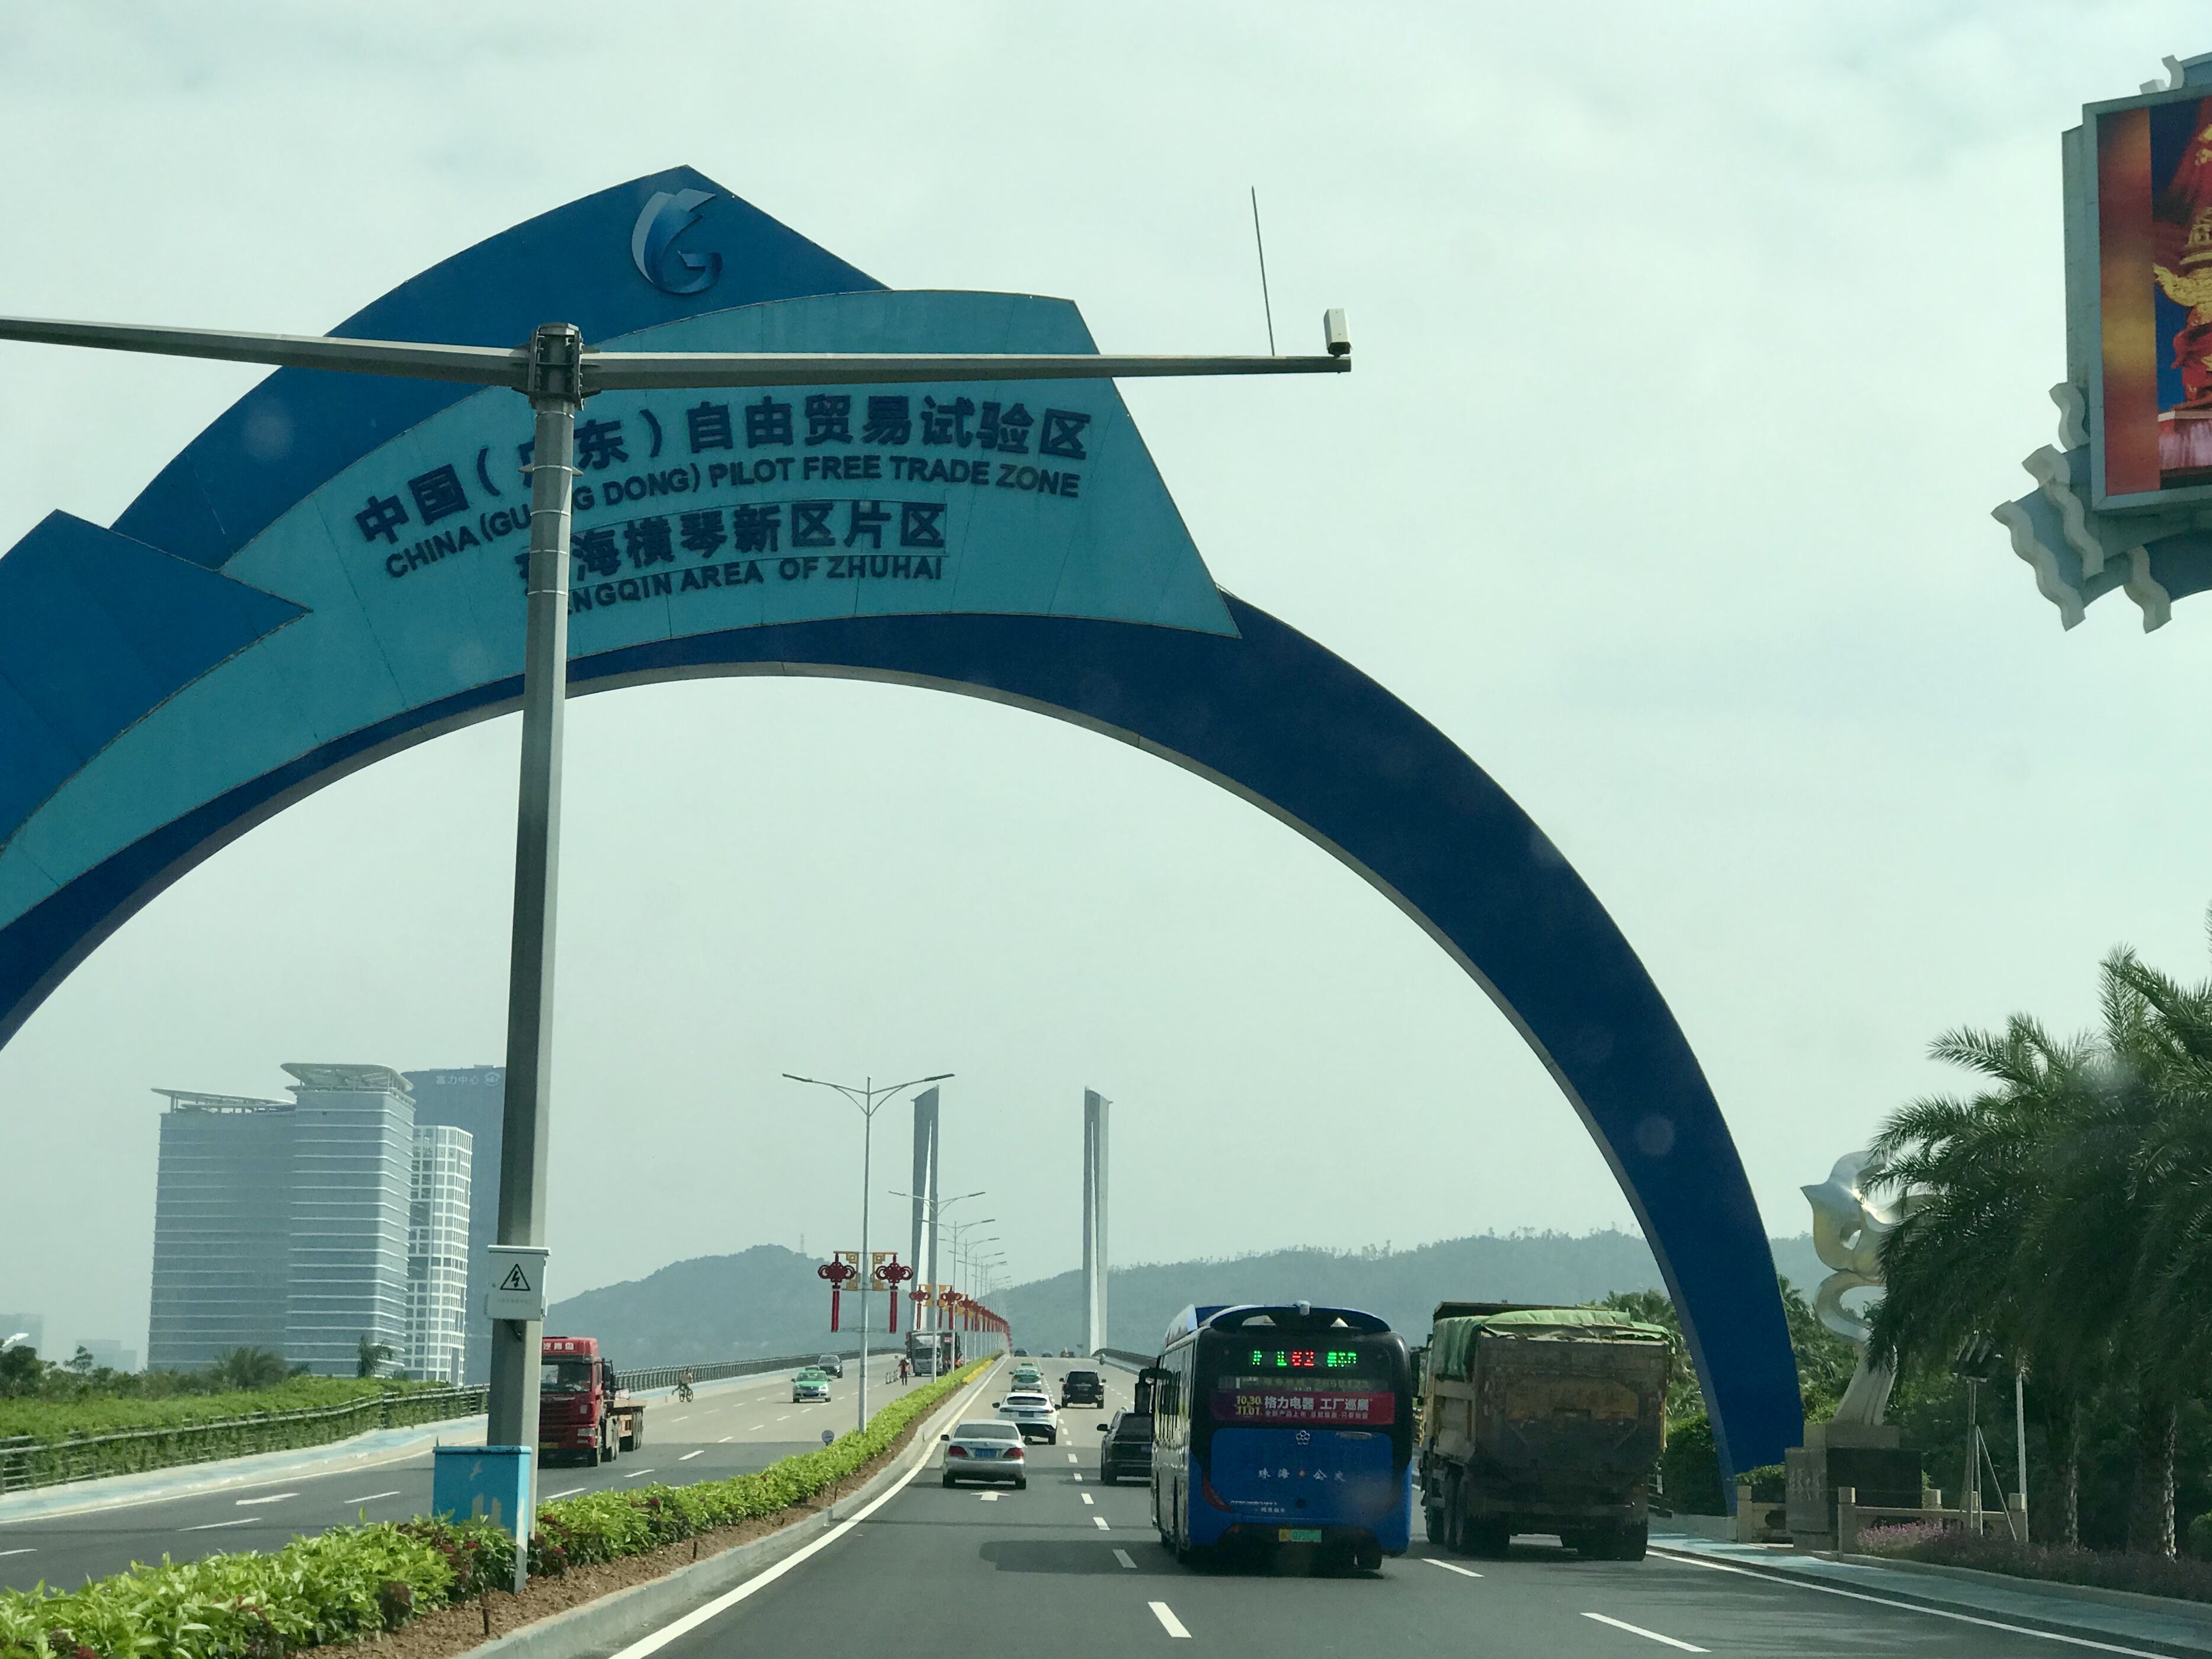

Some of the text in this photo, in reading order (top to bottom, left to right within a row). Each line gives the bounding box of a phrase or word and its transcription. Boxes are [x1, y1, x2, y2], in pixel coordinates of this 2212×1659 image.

[386, 454, 1081, 578] CHINA (GUG DONG) PILOT FREE TRADE ZONE
[681, 559, 764, 592] AREA
[779, 557, 819, 581] OF
[828, 556, 942, 581] ZHUHAI
[436, 1075, 479, 1085] 富力中心
[1265, 1395, 1369, 1411] 格力电器 工厂巡展
